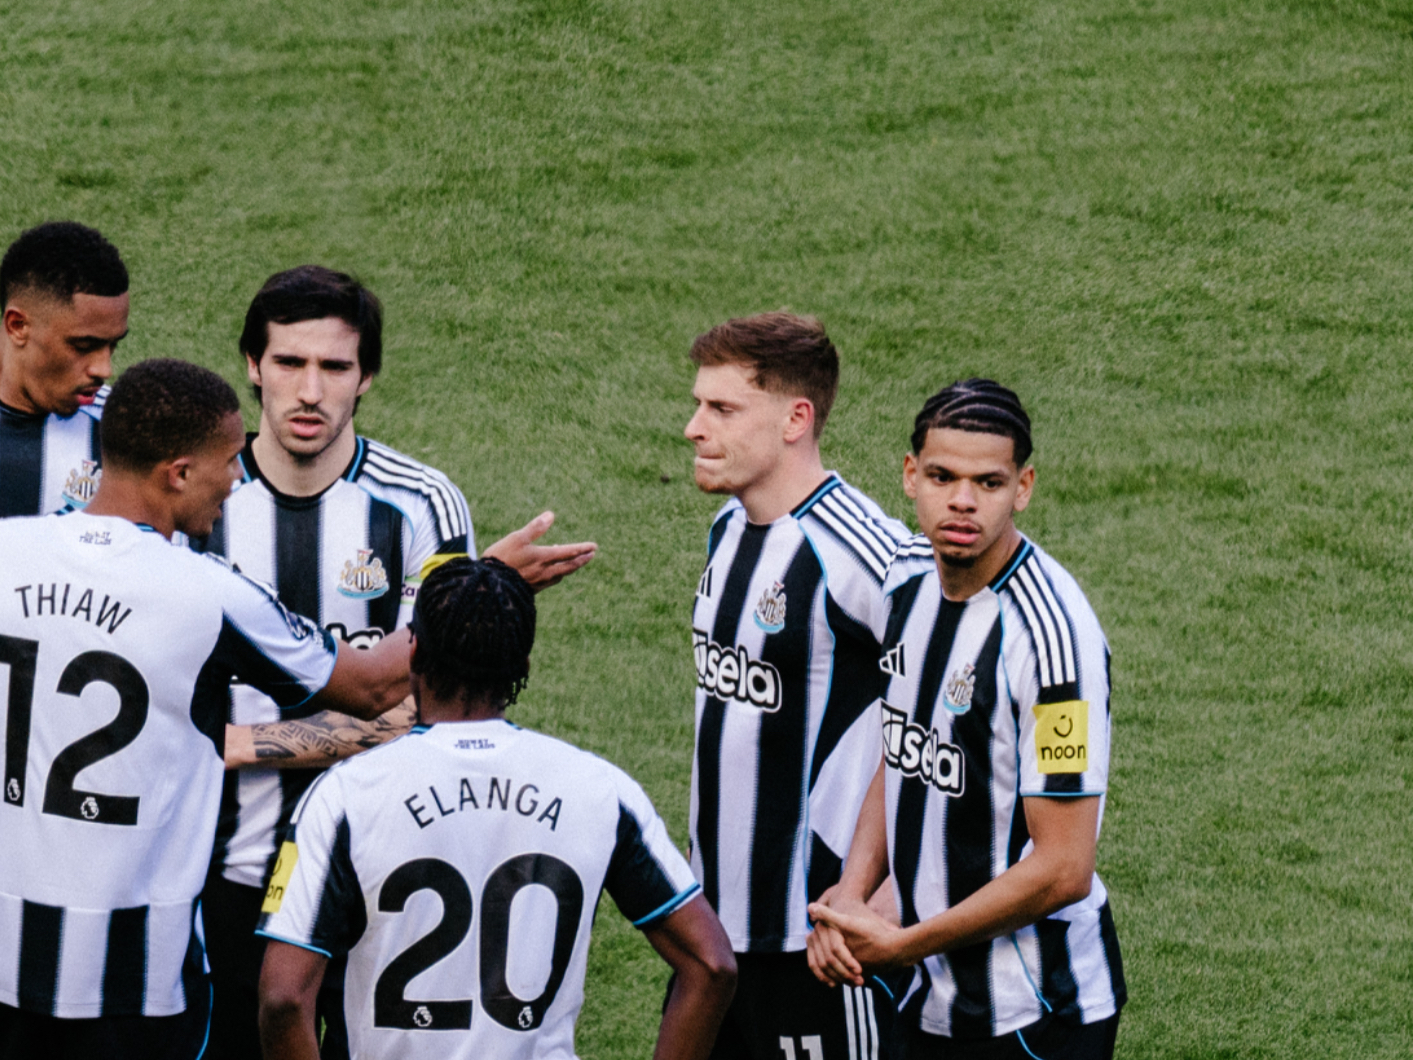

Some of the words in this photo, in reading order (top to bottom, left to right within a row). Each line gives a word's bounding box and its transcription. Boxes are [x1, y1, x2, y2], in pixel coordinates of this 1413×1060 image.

[14, 583, 133, 635] THIAW
[704, 646, 777, 707] sela
[900, 729, 961, 790] sela
[1041, 744, 1086, 761] noon
[404, 777, 563, 832] ELANGA
[374, 853, 584, 1031] 20
